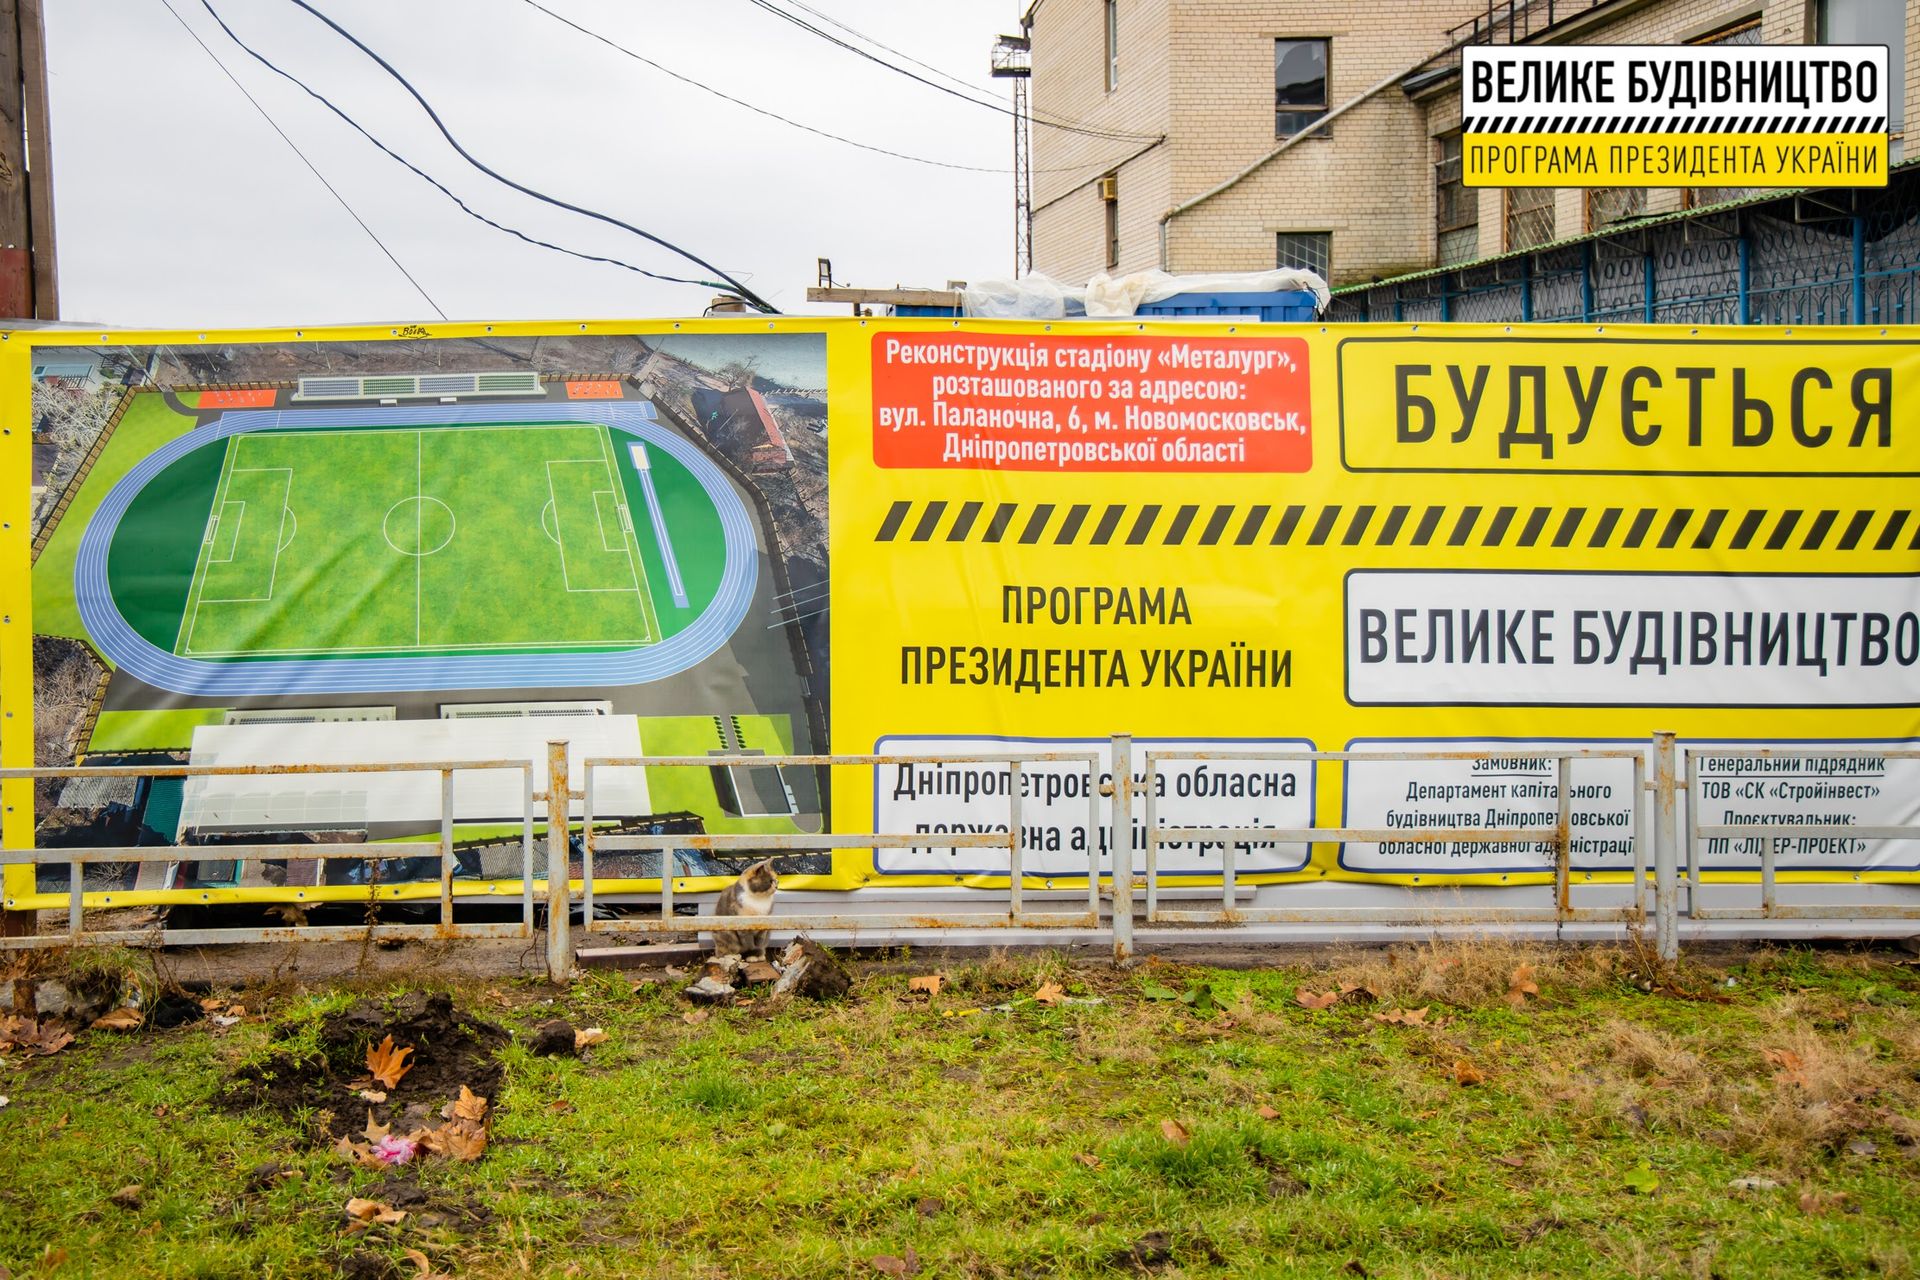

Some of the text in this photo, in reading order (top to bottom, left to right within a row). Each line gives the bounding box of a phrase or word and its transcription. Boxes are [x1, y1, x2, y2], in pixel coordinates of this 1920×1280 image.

[886, 339, 1297, 374] Реконструкція стадіону «Металург»,
[932, 375, 1247, 406] розташованого за адресою:
[879, 402, 1307, 435] вул. Паланочна, 6, м. Новомосковськ,
[1394, 364, 1893, 460] БУДУЄТЬСЯ
[943, 433, 1246, 466] Дніпропетровської області
[1002, 585, 1192, 625] ПРОГРАМА
[1359, 608, 1920, 677] ВЕЛИКЕ БУДІВНИЦТВО
[901, 641, 1292, 695] ПРЕЗИДЕНТА УКРАЇНИ
[1176, 765, 1297, 799] обласна
[1406, 781, 1612, 803] Департамент капітаьного
[1702, 781, 1880, 803] ТОВ «СК «Стройінвест»
[1386, 808, 1632, 829] будівництва Дніпропетовської
[1708, 837, 1729, 854] ПП
